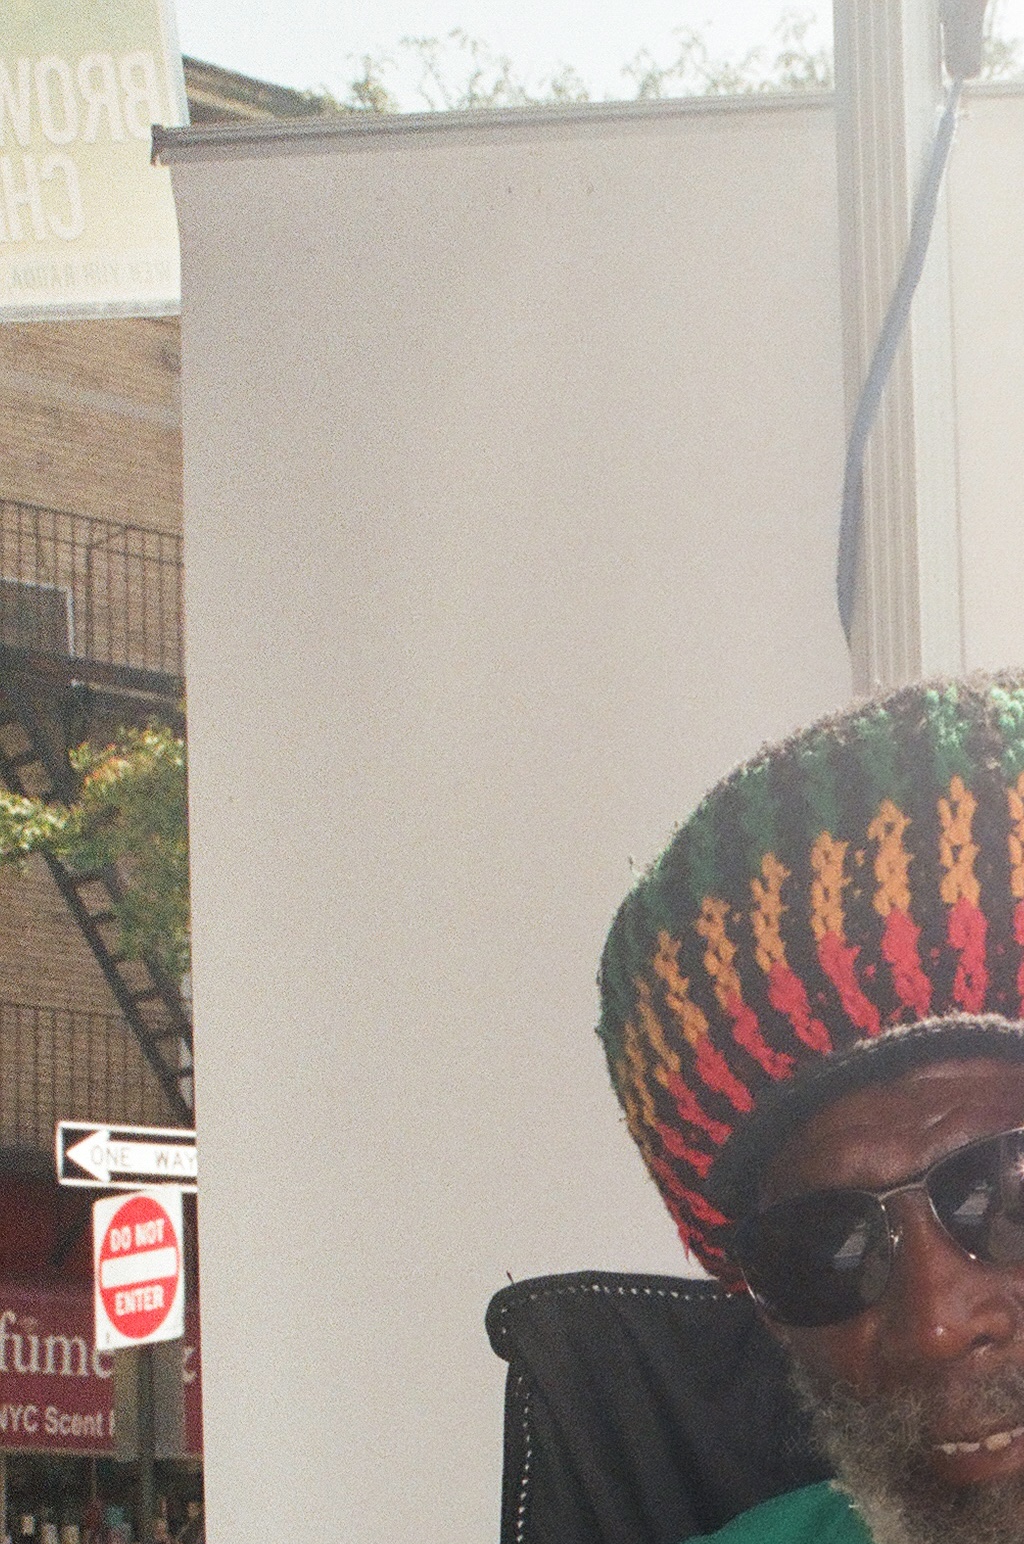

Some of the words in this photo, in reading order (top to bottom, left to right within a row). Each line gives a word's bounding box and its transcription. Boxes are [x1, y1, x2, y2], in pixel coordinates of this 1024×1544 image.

[90, 1145, 131, 1167] ONE
[155, 1150, 197, 1170] WAY
[110, 1226, 132, 1252] DO
[135, 1218, 165, 1247] NOT
[115, 1284, 164, 1316] ENTER
